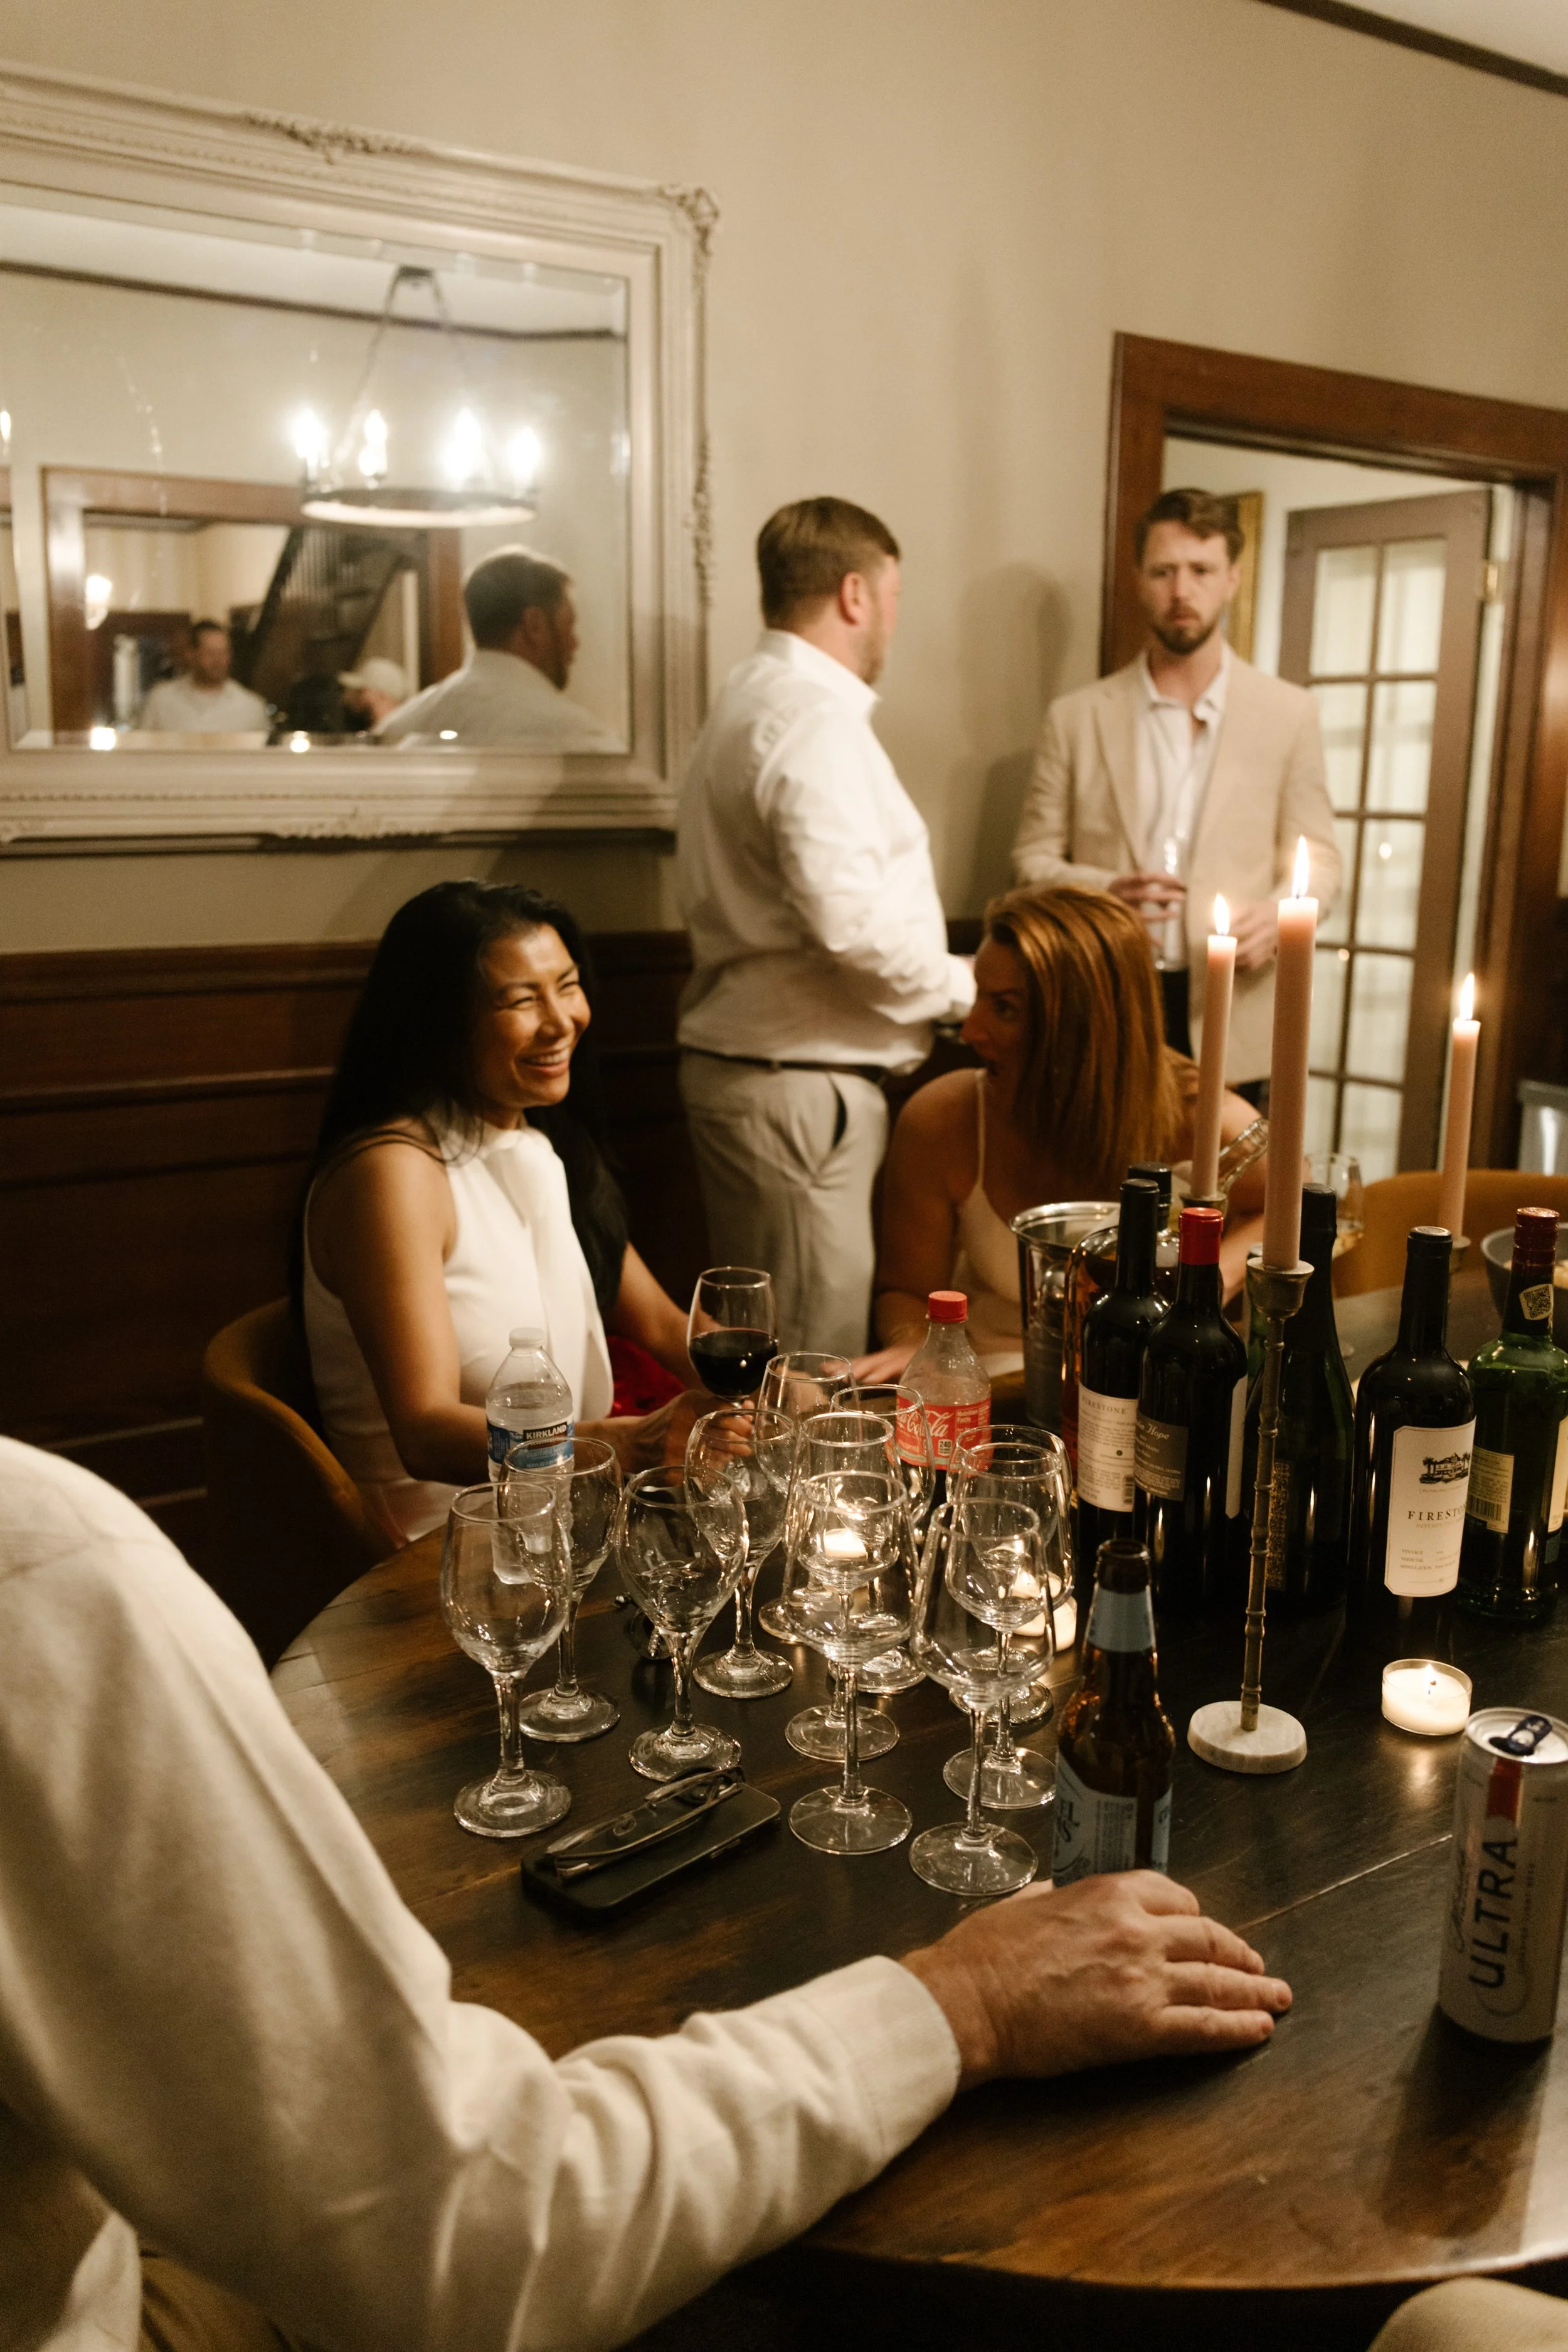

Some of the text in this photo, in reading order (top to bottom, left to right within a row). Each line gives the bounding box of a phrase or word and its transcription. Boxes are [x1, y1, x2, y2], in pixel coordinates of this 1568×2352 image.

[526, 1424, 568, 1440] KIRKLAND
[1146, 1422, 1170, 1440] Hope
[1468, 1836, 1518, 1989] ULTRA
